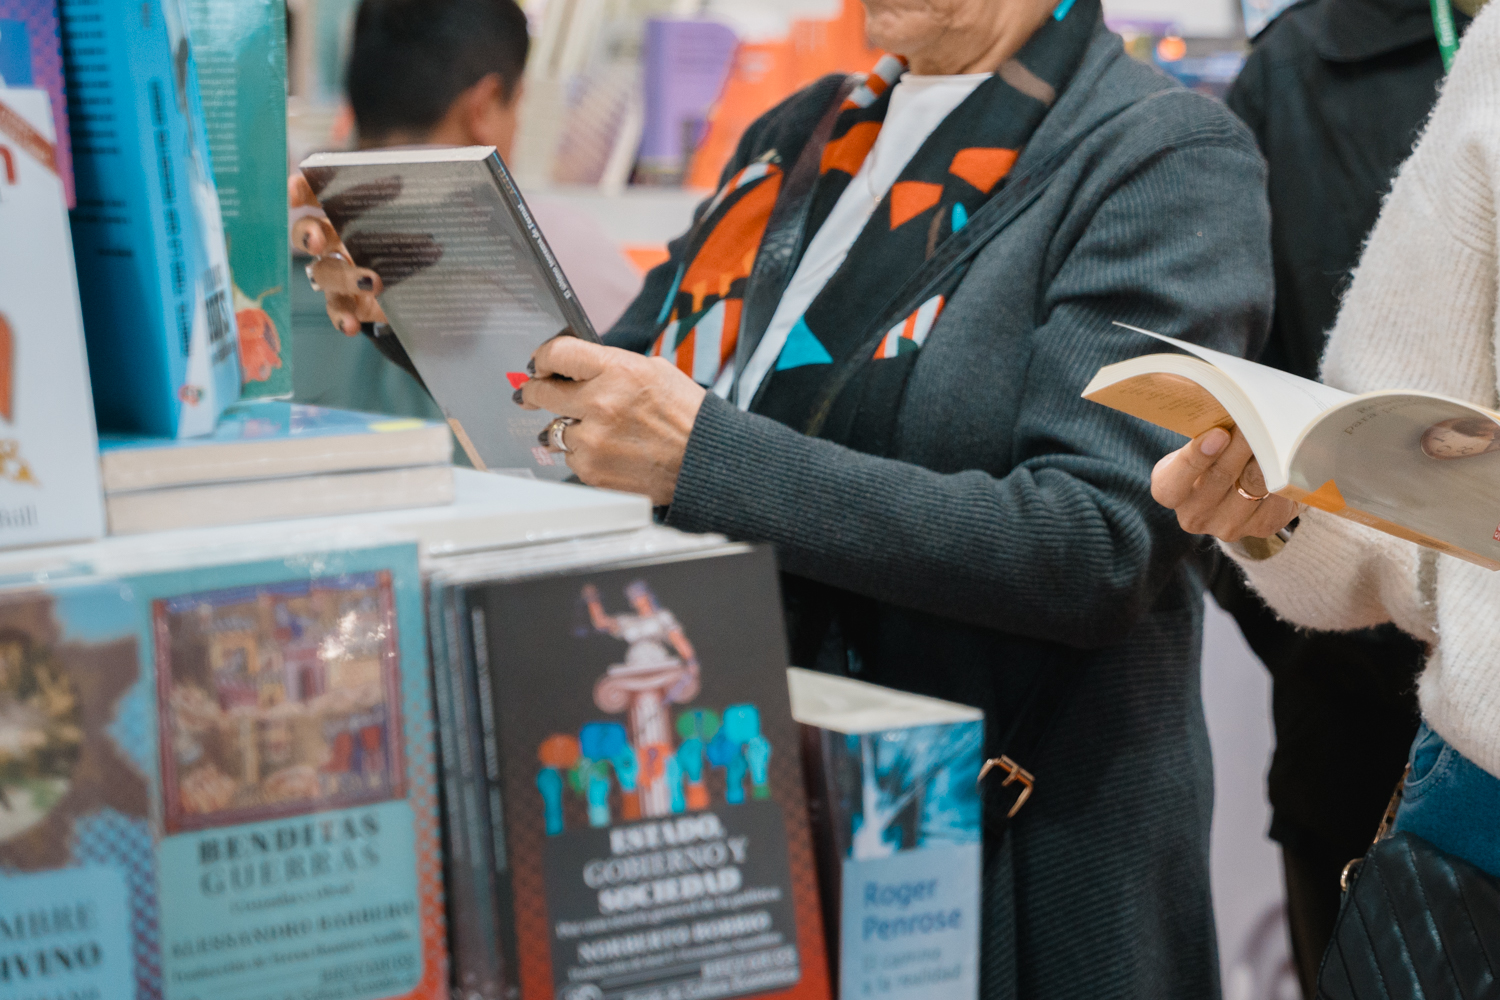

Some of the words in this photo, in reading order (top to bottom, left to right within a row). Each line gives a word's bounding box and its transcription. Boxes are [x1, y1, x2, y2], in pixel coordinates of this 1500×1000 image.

[517, 202, 537, 230] Fermat
[199, 814, 379, 864] BENDITAS
[608, 811, 728, 855] ESTADO,
[200, 845, 380, 896] GUERRAS
[582, 840, 728, 889] GOBIERNO
[728, 837, 747, 864] Y
[597, 866, 743, 915] SOCIEDAD
[864, 877, 938, 908] Roger
[862, 907, 961, 941] Penrose
